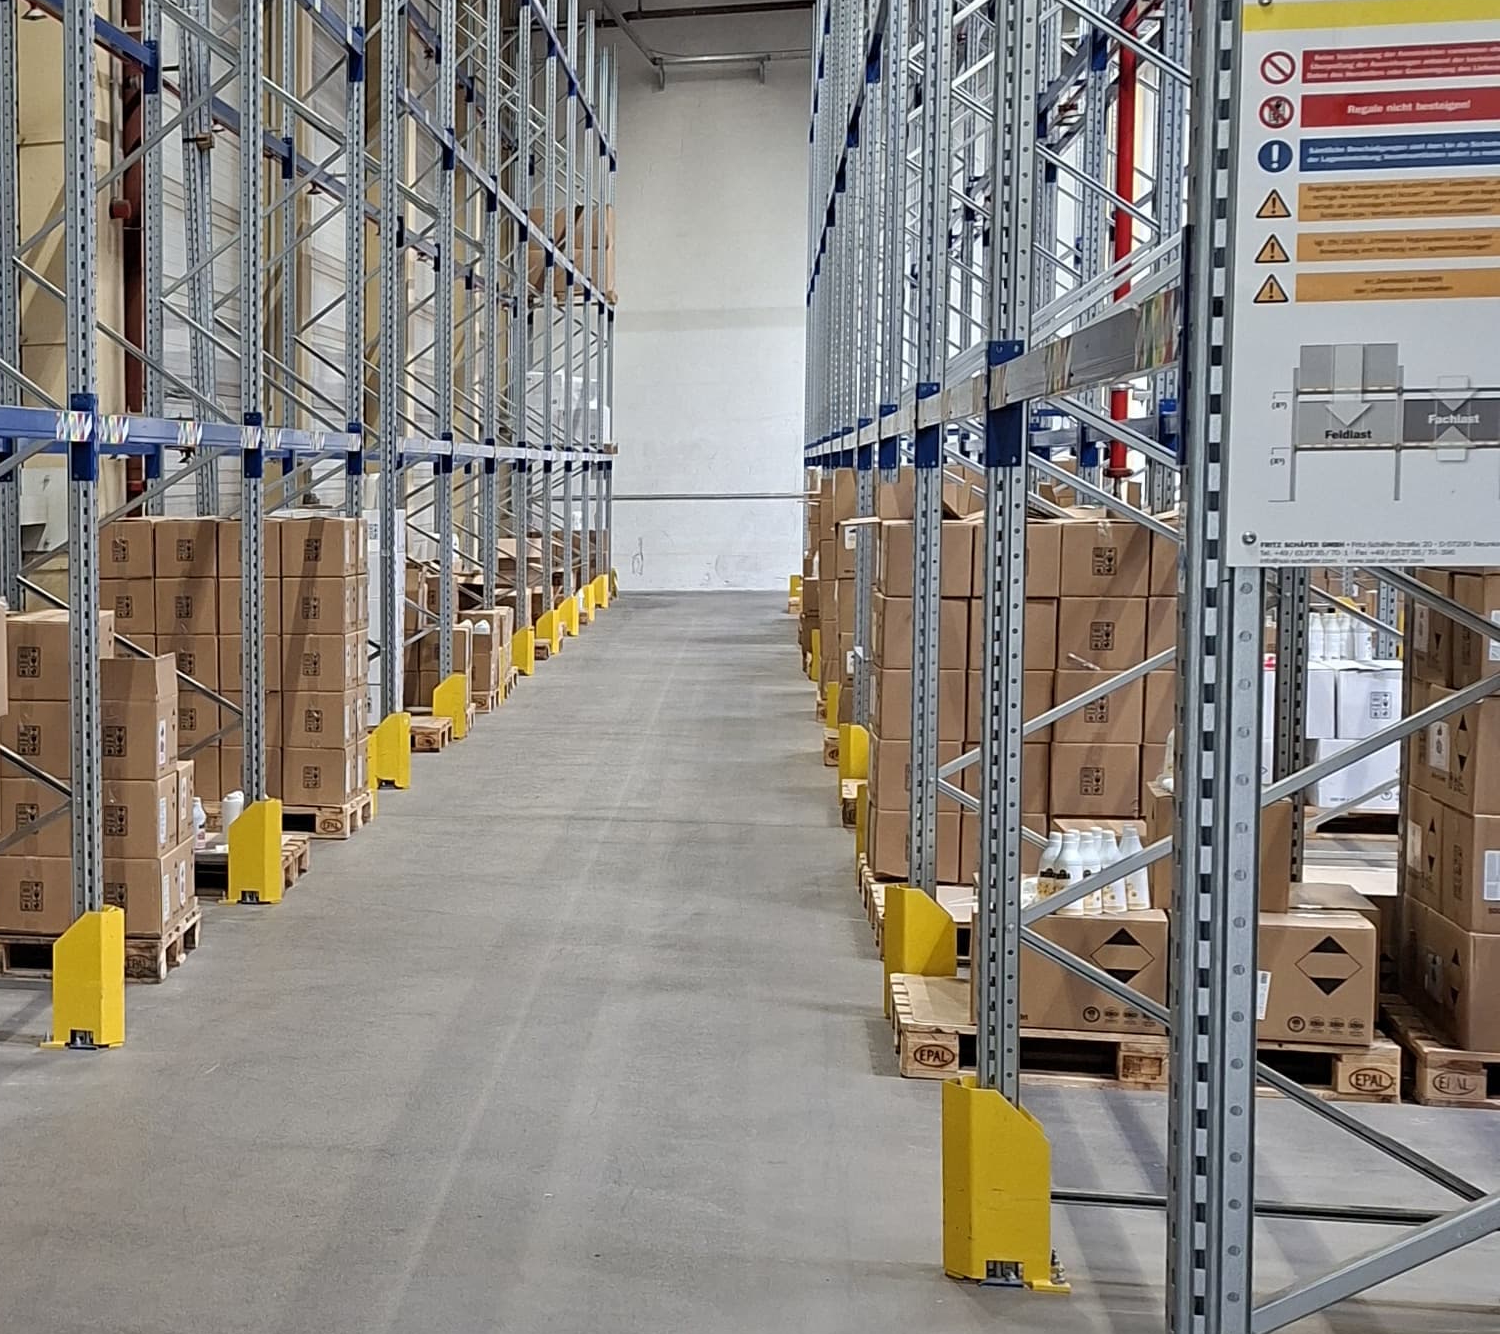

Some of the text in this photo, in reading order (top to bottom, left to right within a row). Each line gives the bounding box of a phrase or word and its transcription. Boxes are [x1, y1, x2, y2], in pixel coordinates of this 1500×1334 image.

[1347, 99, 1471, 115] Regale nicht besteigen!
[1428, 414, 1480, 424] Fachlast
[1325, 430, 1372, 439] Feldlast
[920, 1049, 948, 1063] EPAL
[1355, 1073, 1388, 1088] EPAL
